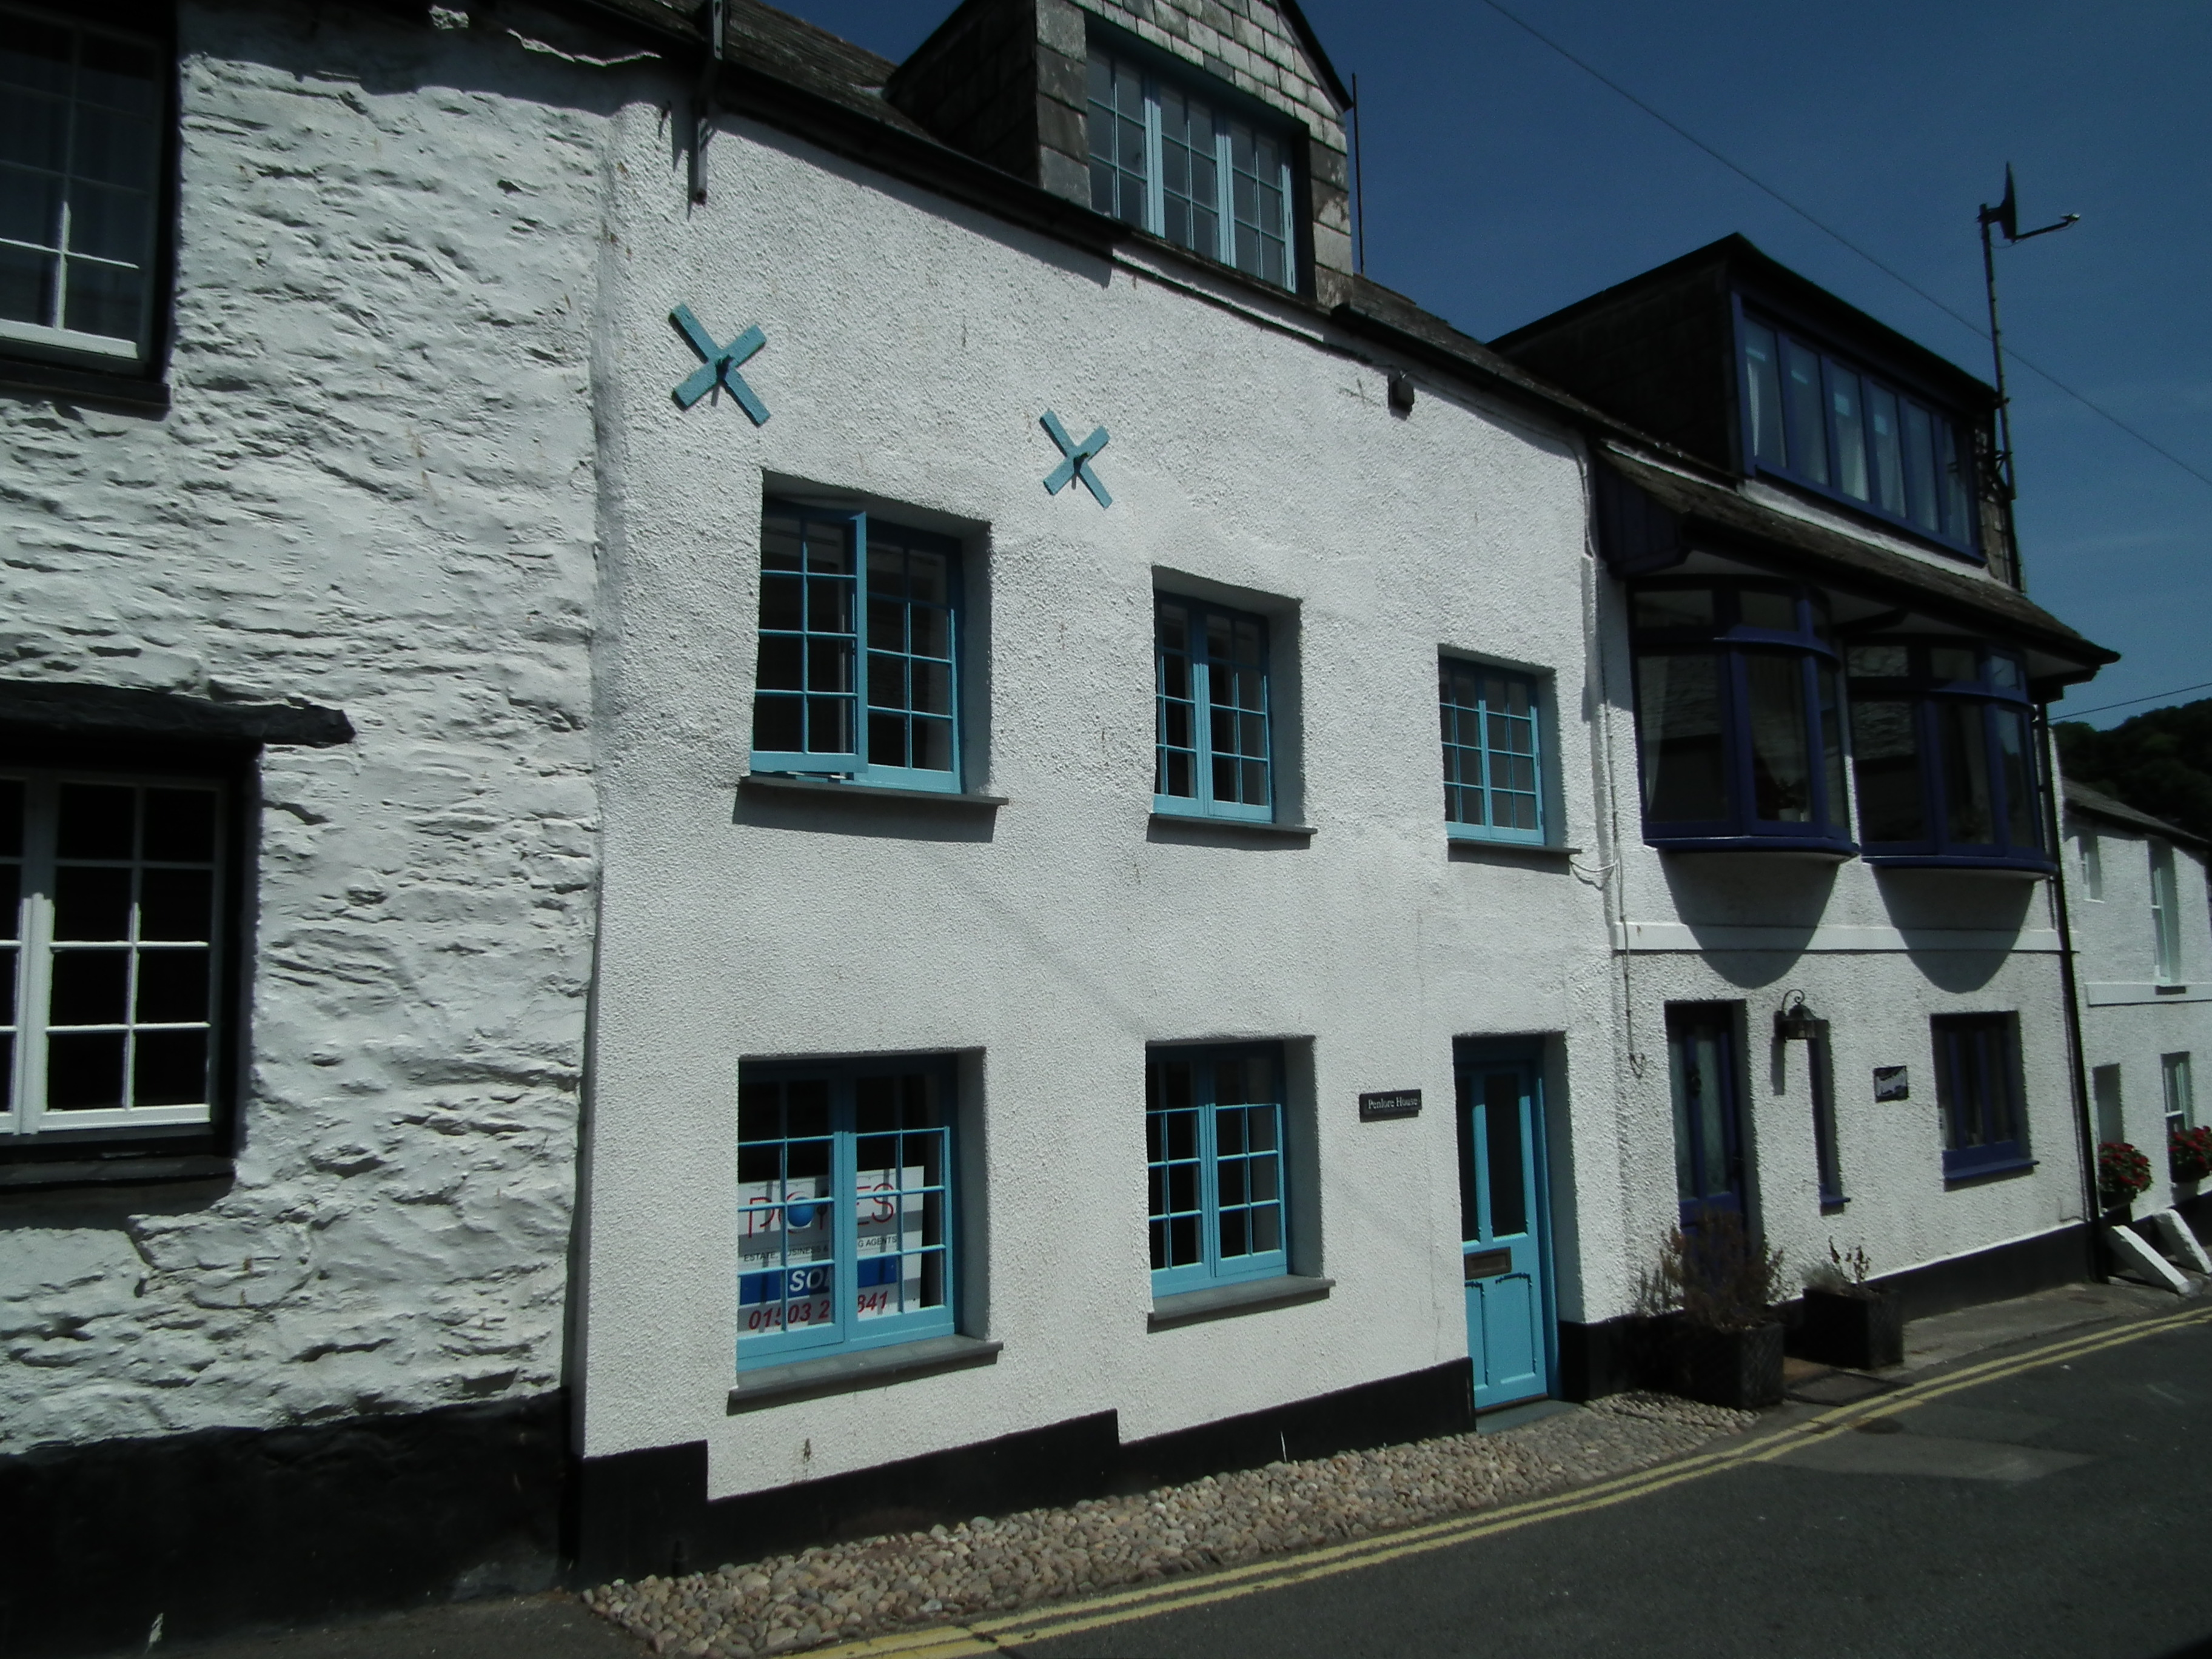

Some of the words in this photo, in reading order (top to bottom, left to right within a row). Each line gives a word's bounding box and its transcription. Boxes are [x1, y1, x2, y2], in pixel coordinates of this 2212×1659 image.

[1396, 1096, 1418, 1107] House
[787, 1245, 821, 1256] USINESS
[866, 1236, 897, 1247] AGENTS
